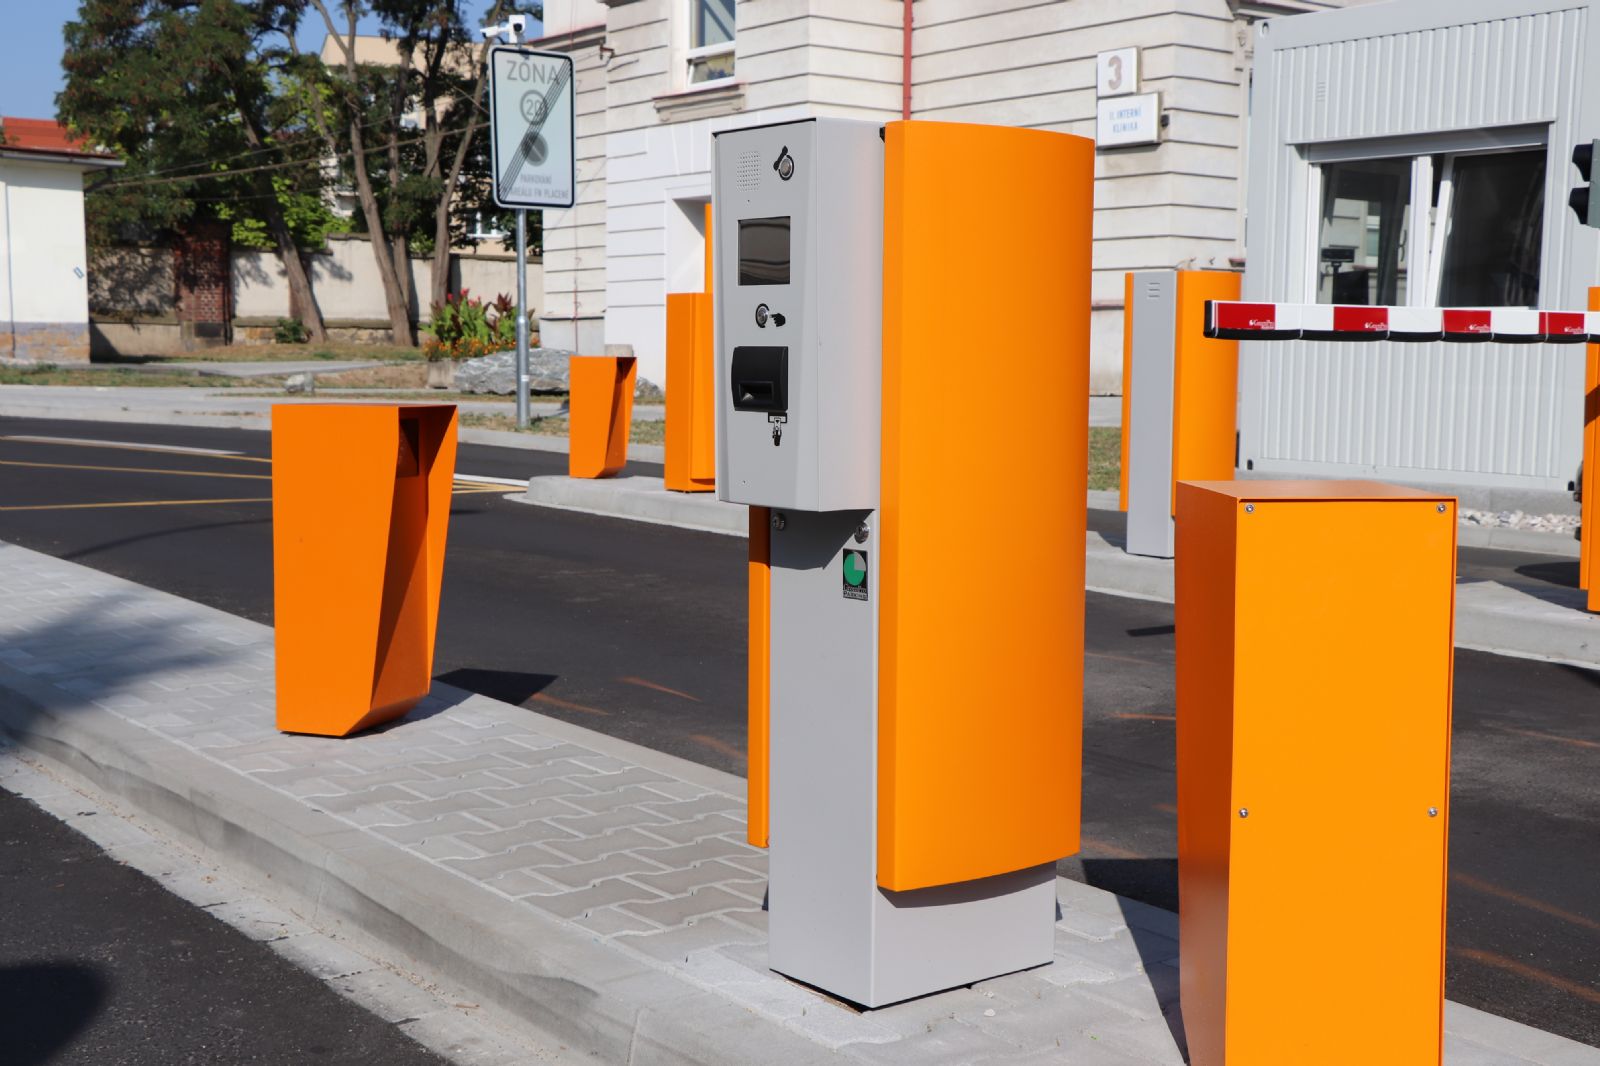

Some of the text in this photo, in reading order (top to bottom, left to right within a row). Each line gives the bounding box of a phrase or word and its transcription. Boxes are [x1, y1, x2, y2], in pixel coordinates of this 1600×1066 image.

[506, 60, 560, 85] ZONA
[1108, 55, 1122, 90] 3
[526, 98, 543, 117] 20
